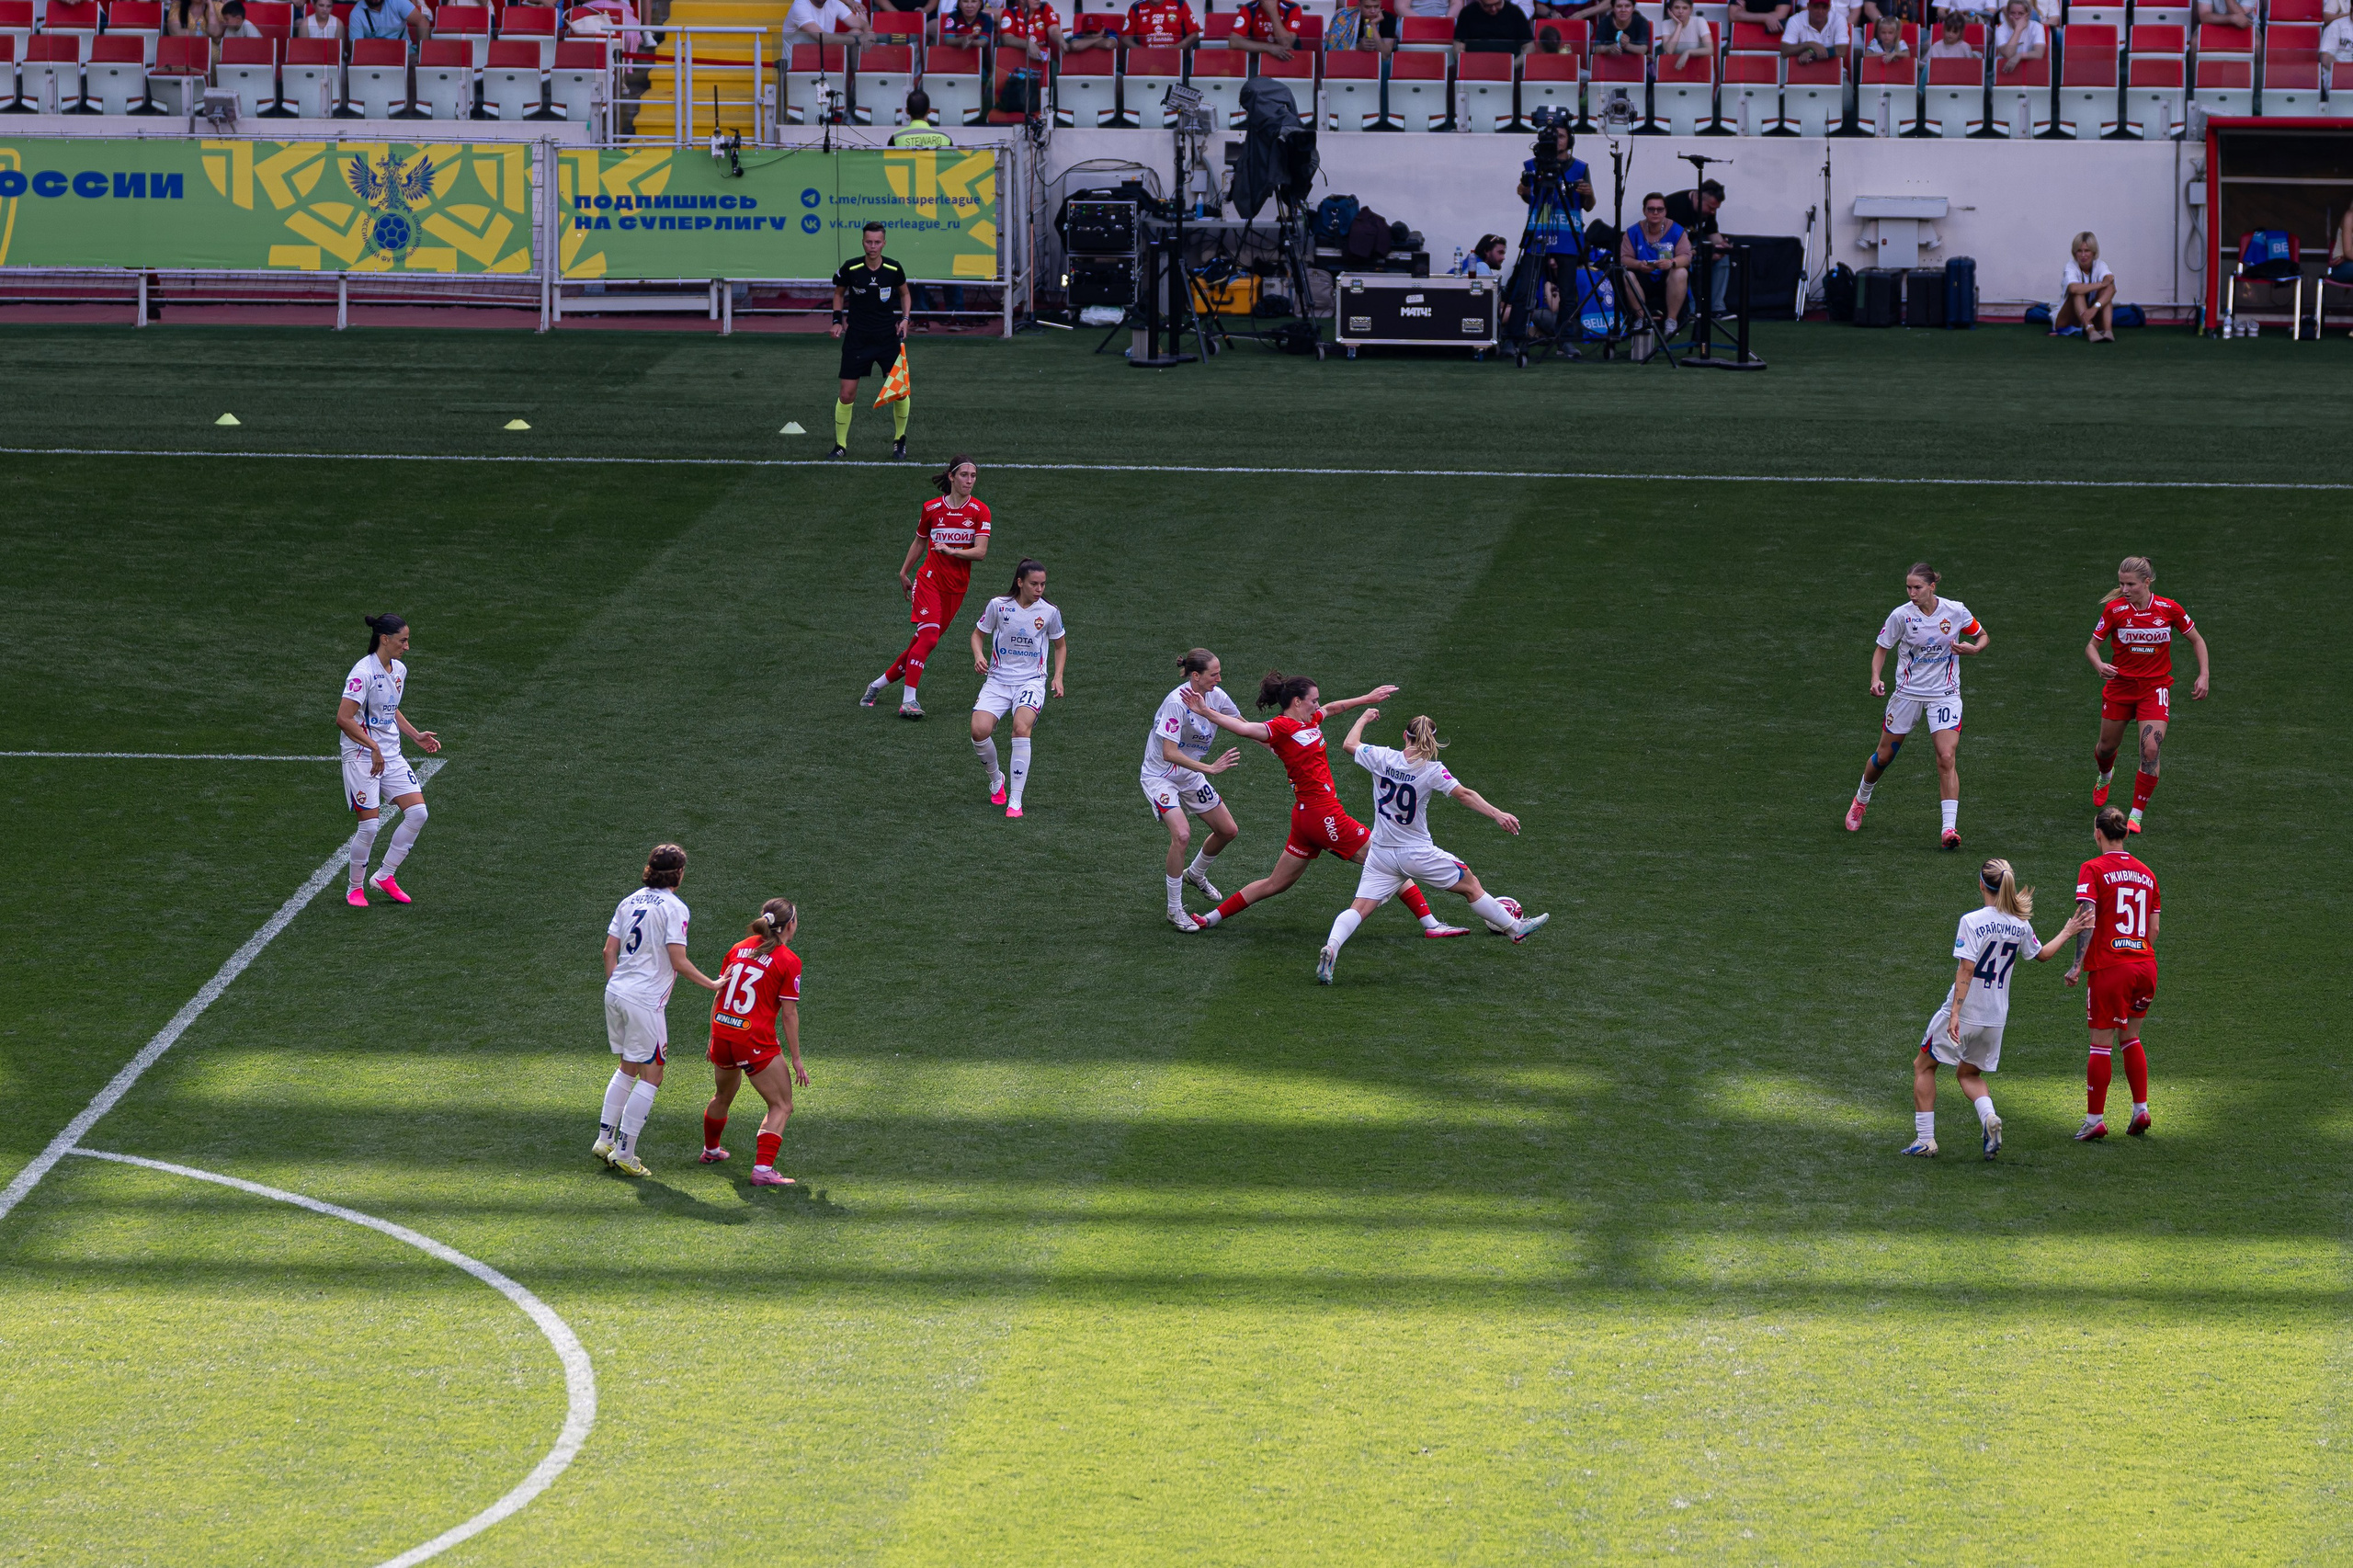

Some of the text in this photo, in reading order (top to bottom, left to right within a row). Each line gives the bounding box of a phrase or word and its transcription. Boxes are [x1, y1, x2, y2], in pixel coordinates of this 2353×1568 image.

[904, 136, 942, 147] STEWARD
[574, 194, 758, 211] ПОДПИШИСЬ
[828, 194, 981, 207] t.me/russiansuperleague
[574, 215, 787, 231] НА СУПЕРЛИГУ
[829, 218, 961, 232] vk.ru/sperleague_ru
[935, 531, 974, 541] ЛУКОЙЛ
[1010, 636, 1034, 645] РОТА
[2125, 631, 2167, 642] ЛУКОЙЛ
[1920, 644, 1943, 653] РОТА
[1018, 689, 1034, 704] 21
[2155, 687, 2169, 708] 10
[1937, 707, 1950, 723] 10
[407, 769, 417, 785] 6
[1196, 784, 1214, 804] 89
[1378, 776, 1417, 825] 29
[2115, 886, 2147, 937] 51
[626, 908, 648, 956] 3
[1973, 940, 2020, 990] 47
[722, 961, 765, 1016] 13
[715, 1013, 743, 1028] WINLINE
